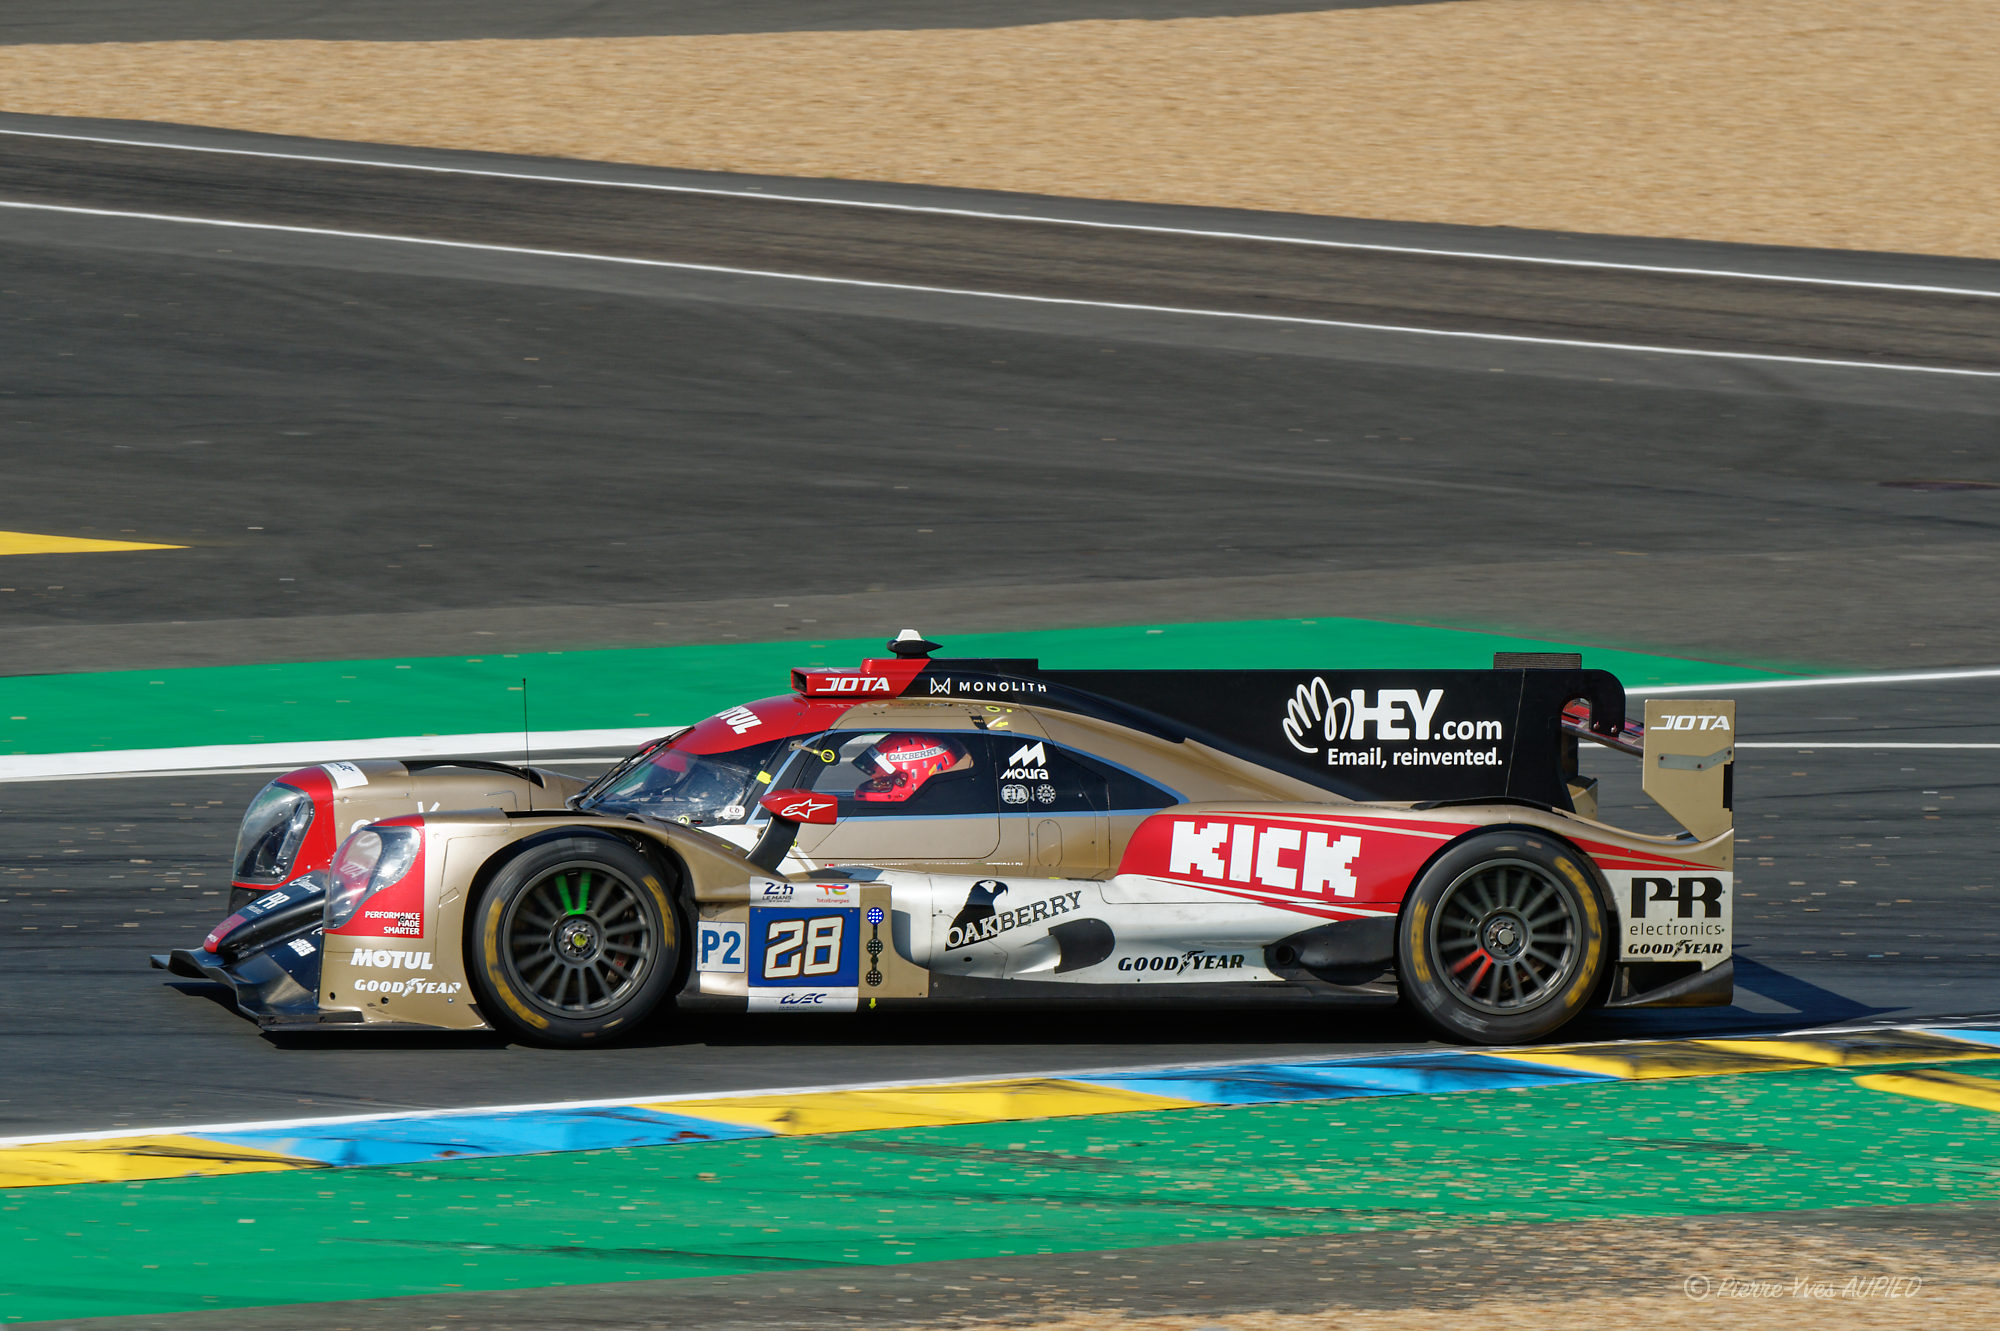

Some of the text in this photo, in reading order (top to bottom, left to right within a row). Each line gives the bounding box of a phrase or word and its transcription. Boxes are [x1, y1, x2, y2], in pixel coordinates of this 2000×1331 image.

[816, 677, 890, 692] JOTA
[959, 681, 1047, 692] MONOLITH
[1350, 689, 1502, 740] HEY.com
[1650, 715, 1730, 731] JOTA
[889, 747, 937, 761] OAKBERRY
[1328, 747, 1503, 769] Email, reinvented.
[1002, 786, 1028, 802] FIA
[1169, 821, 1362, 898] KICK
[1631, 877, 1723, 918] PR
[364, 911, 420, 920] PERFORMANCE
[946, 890, 1082, 949] OAKBERRY
[383, 926, 420, 935] SMARTER
[1630, 922, 1721, 936] electronics
[701, 930, 741, 965] P2
[762, 914, 845, 981] 28
[350, 948, 433, 970] MOTUL
